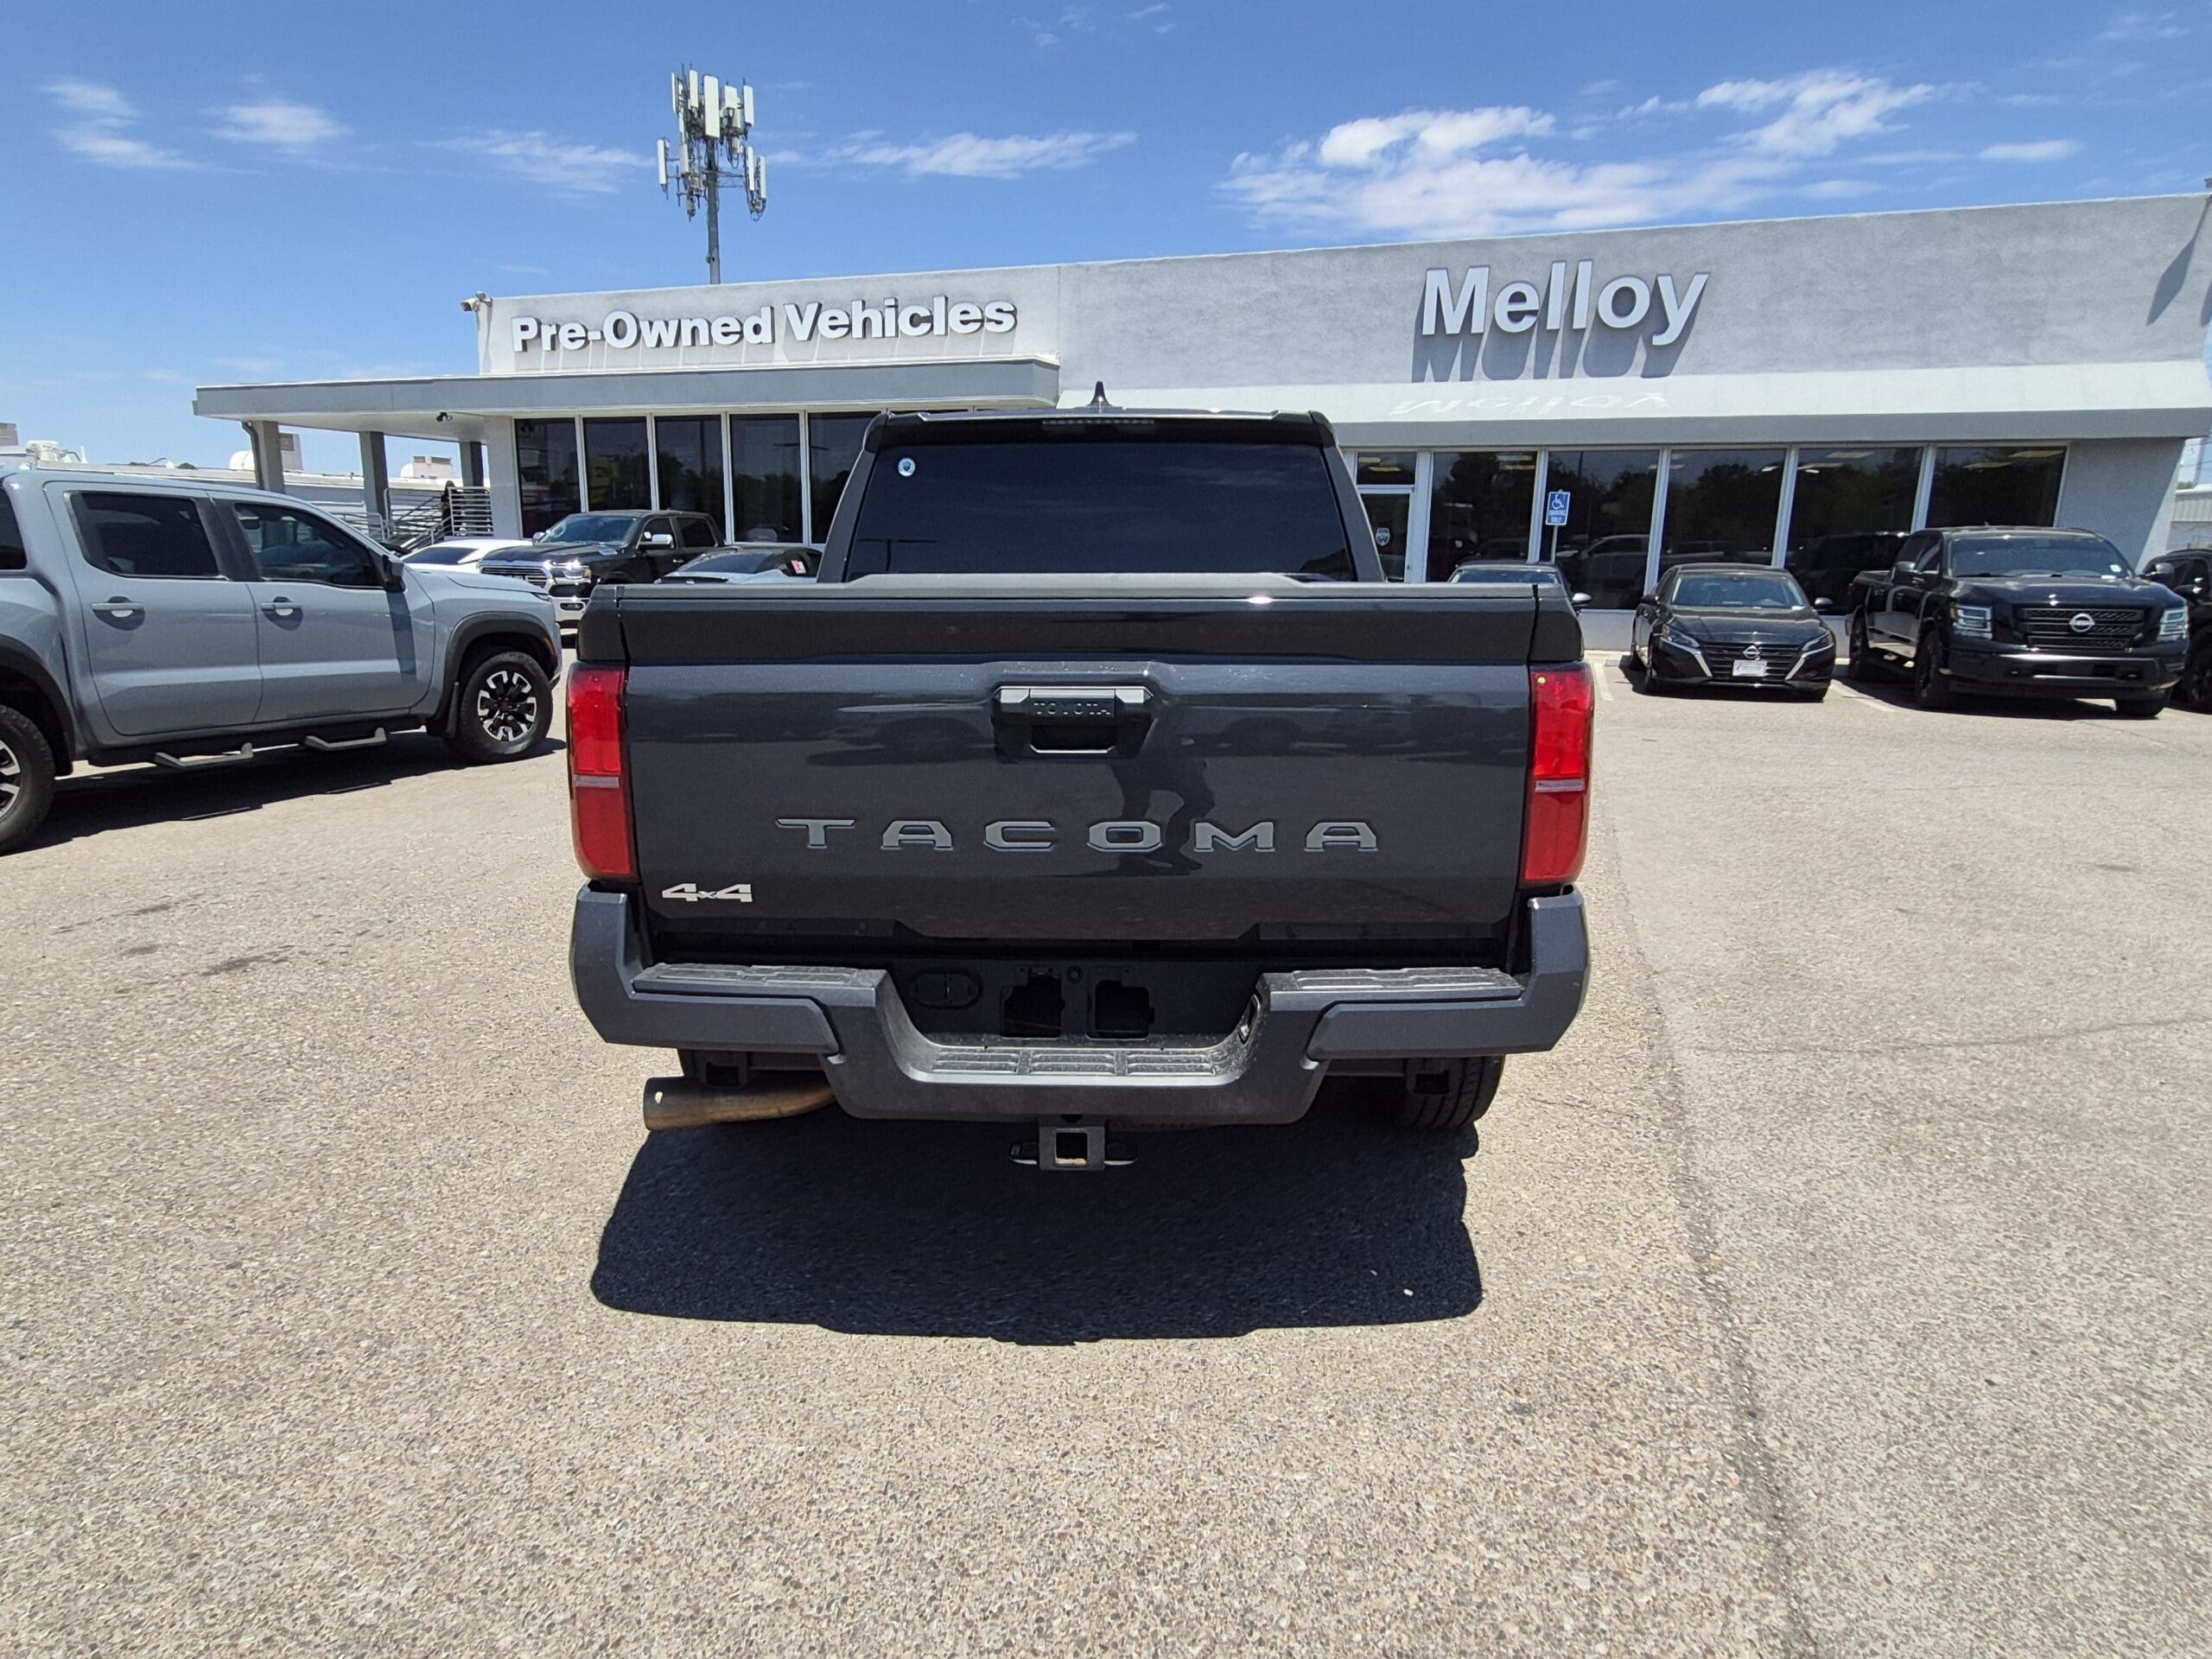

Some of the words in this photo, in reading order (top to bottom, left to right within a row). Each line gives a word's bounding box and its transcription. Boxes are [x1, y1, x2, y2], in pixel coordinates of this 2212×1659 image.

[511, 305, 774, 352] Pre-Owned
[784, 295, 1017, 342] Vehicles
[1422, 259, 1710, 346] Melloy
[775, 817, 1378, 852] TACOMA
[662, 883, 753, 902] 4x4
